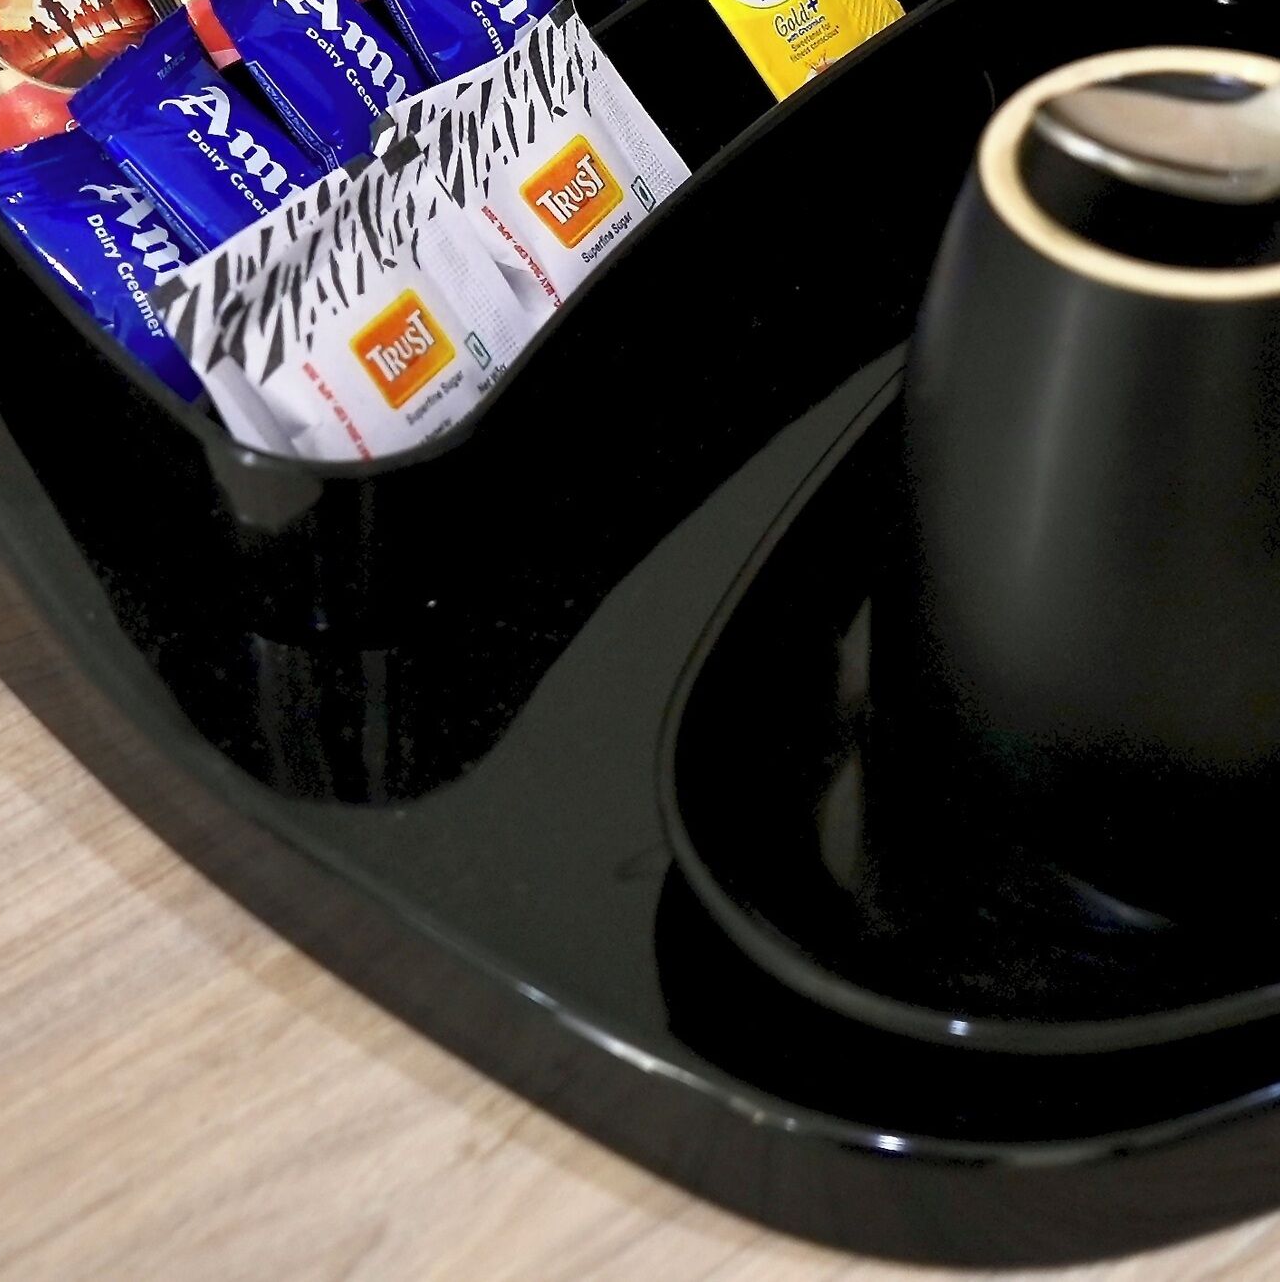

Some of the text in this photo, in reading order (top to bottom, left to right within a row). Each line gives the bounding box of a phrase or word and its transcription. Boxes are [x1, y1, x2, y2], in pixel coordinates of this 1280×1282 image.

[306, 27, 344, 67] Dairy
[187, 129, 229, 171] Dairy
[536, 153, 606, 225] TRUST
[581, 212, 633, 264] Superfine Sugar
[87, 214, 121, 257] Dairy
[117, 262, 164, 337] Creamer
[365, 309, 435, 382] TRUST
